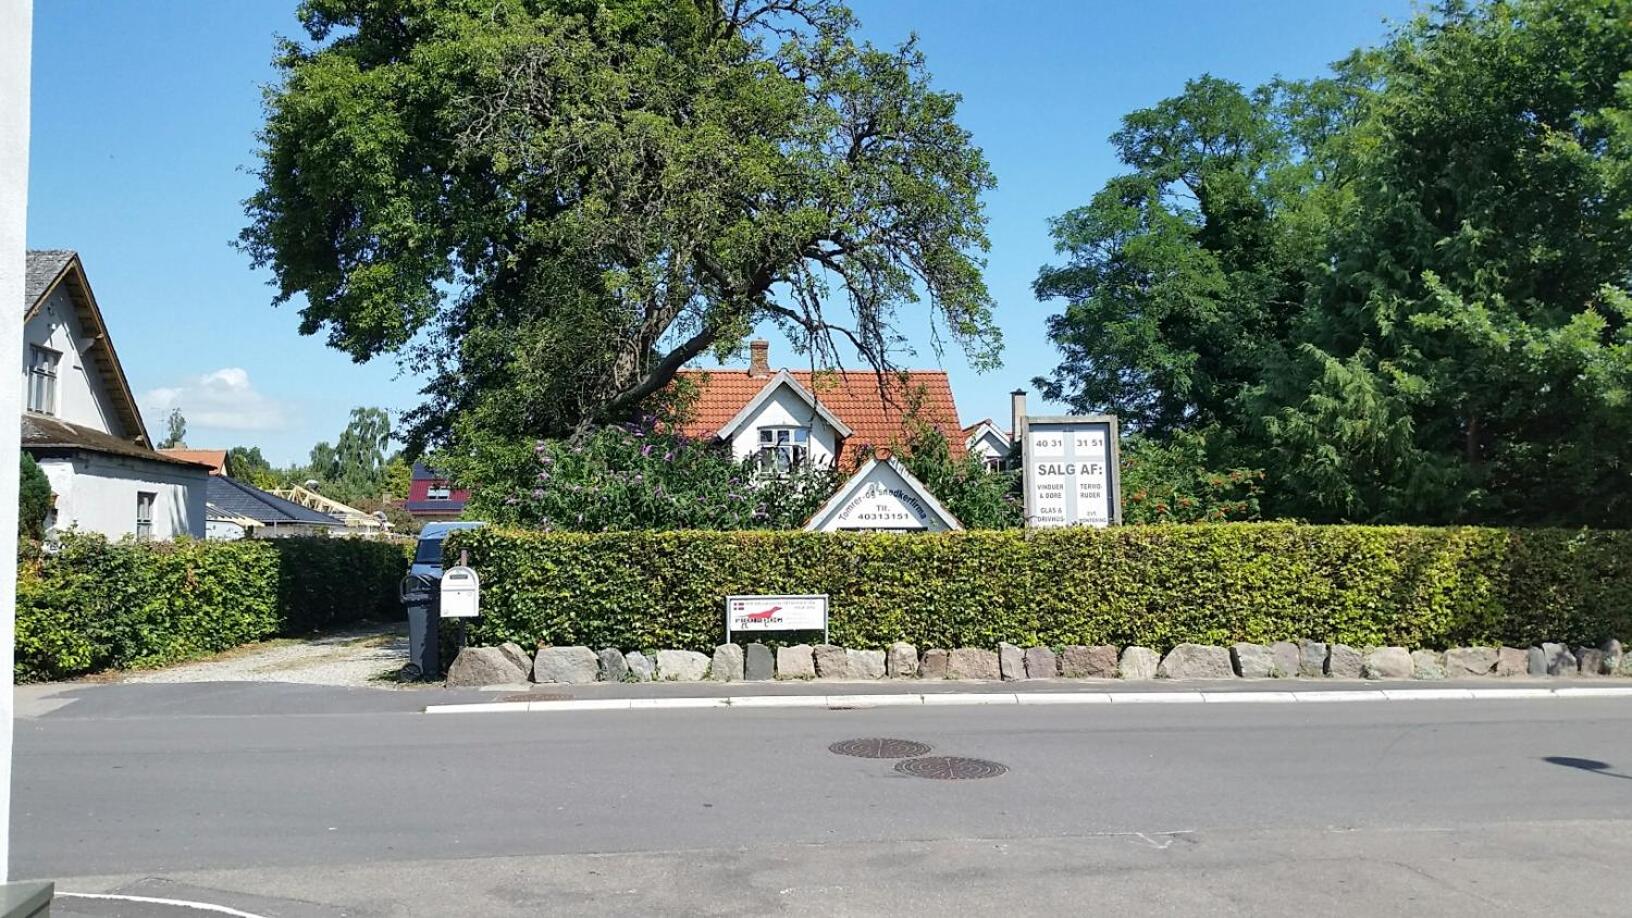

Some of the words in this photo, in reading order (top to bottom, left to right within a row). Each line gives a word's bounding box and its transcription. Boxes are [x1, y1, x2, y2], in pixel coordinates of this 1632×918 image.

[1036, 439, 1048, 447] 40
[1051, 439, 1062, 447] 31
[1077, 439, 1088, 447] 31
[1091, 439, 1103, 447] 51
[1038, 464, 1076, 476] SALG
[1080, 464, 1103, 475] AF:
